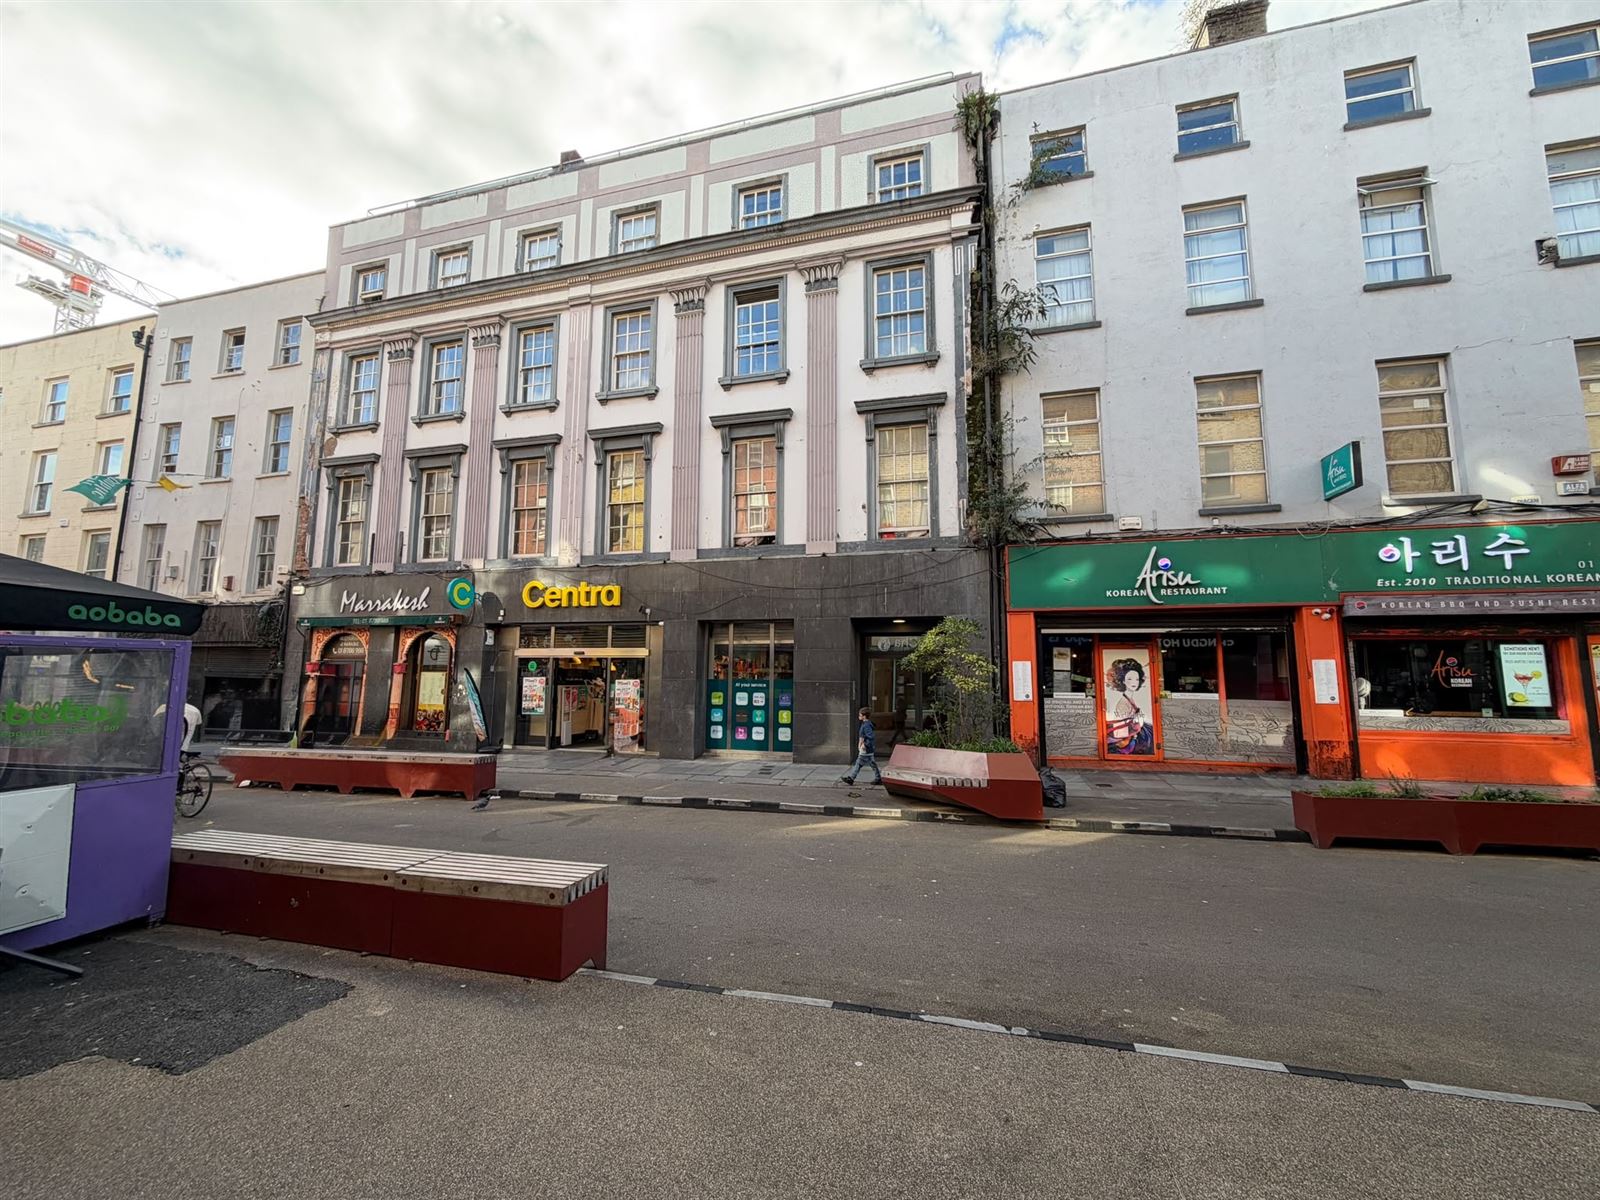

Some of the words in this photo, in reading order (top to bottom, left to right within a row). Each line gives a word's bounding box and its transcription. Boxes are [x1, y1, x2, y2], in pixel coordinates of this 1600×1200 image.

[1378, 533, 1531, 573] 아리수
[1135, 546, 1200, 604] Arisu
[1445, 575, 1541, 585] TRADITIONAL
[340, 586, 430, 613] Marrakesh
[522, 580, 621, 608] Centra
[1106, 589, 1147, 597] KOREAN
[1161, 587, 1227, 596] RESTAURANT
[1440, 601, 1465, 609] BBQ
[68, 601, 180, 627] aobaba
[1431, 650, 1478, 688] Arisu
